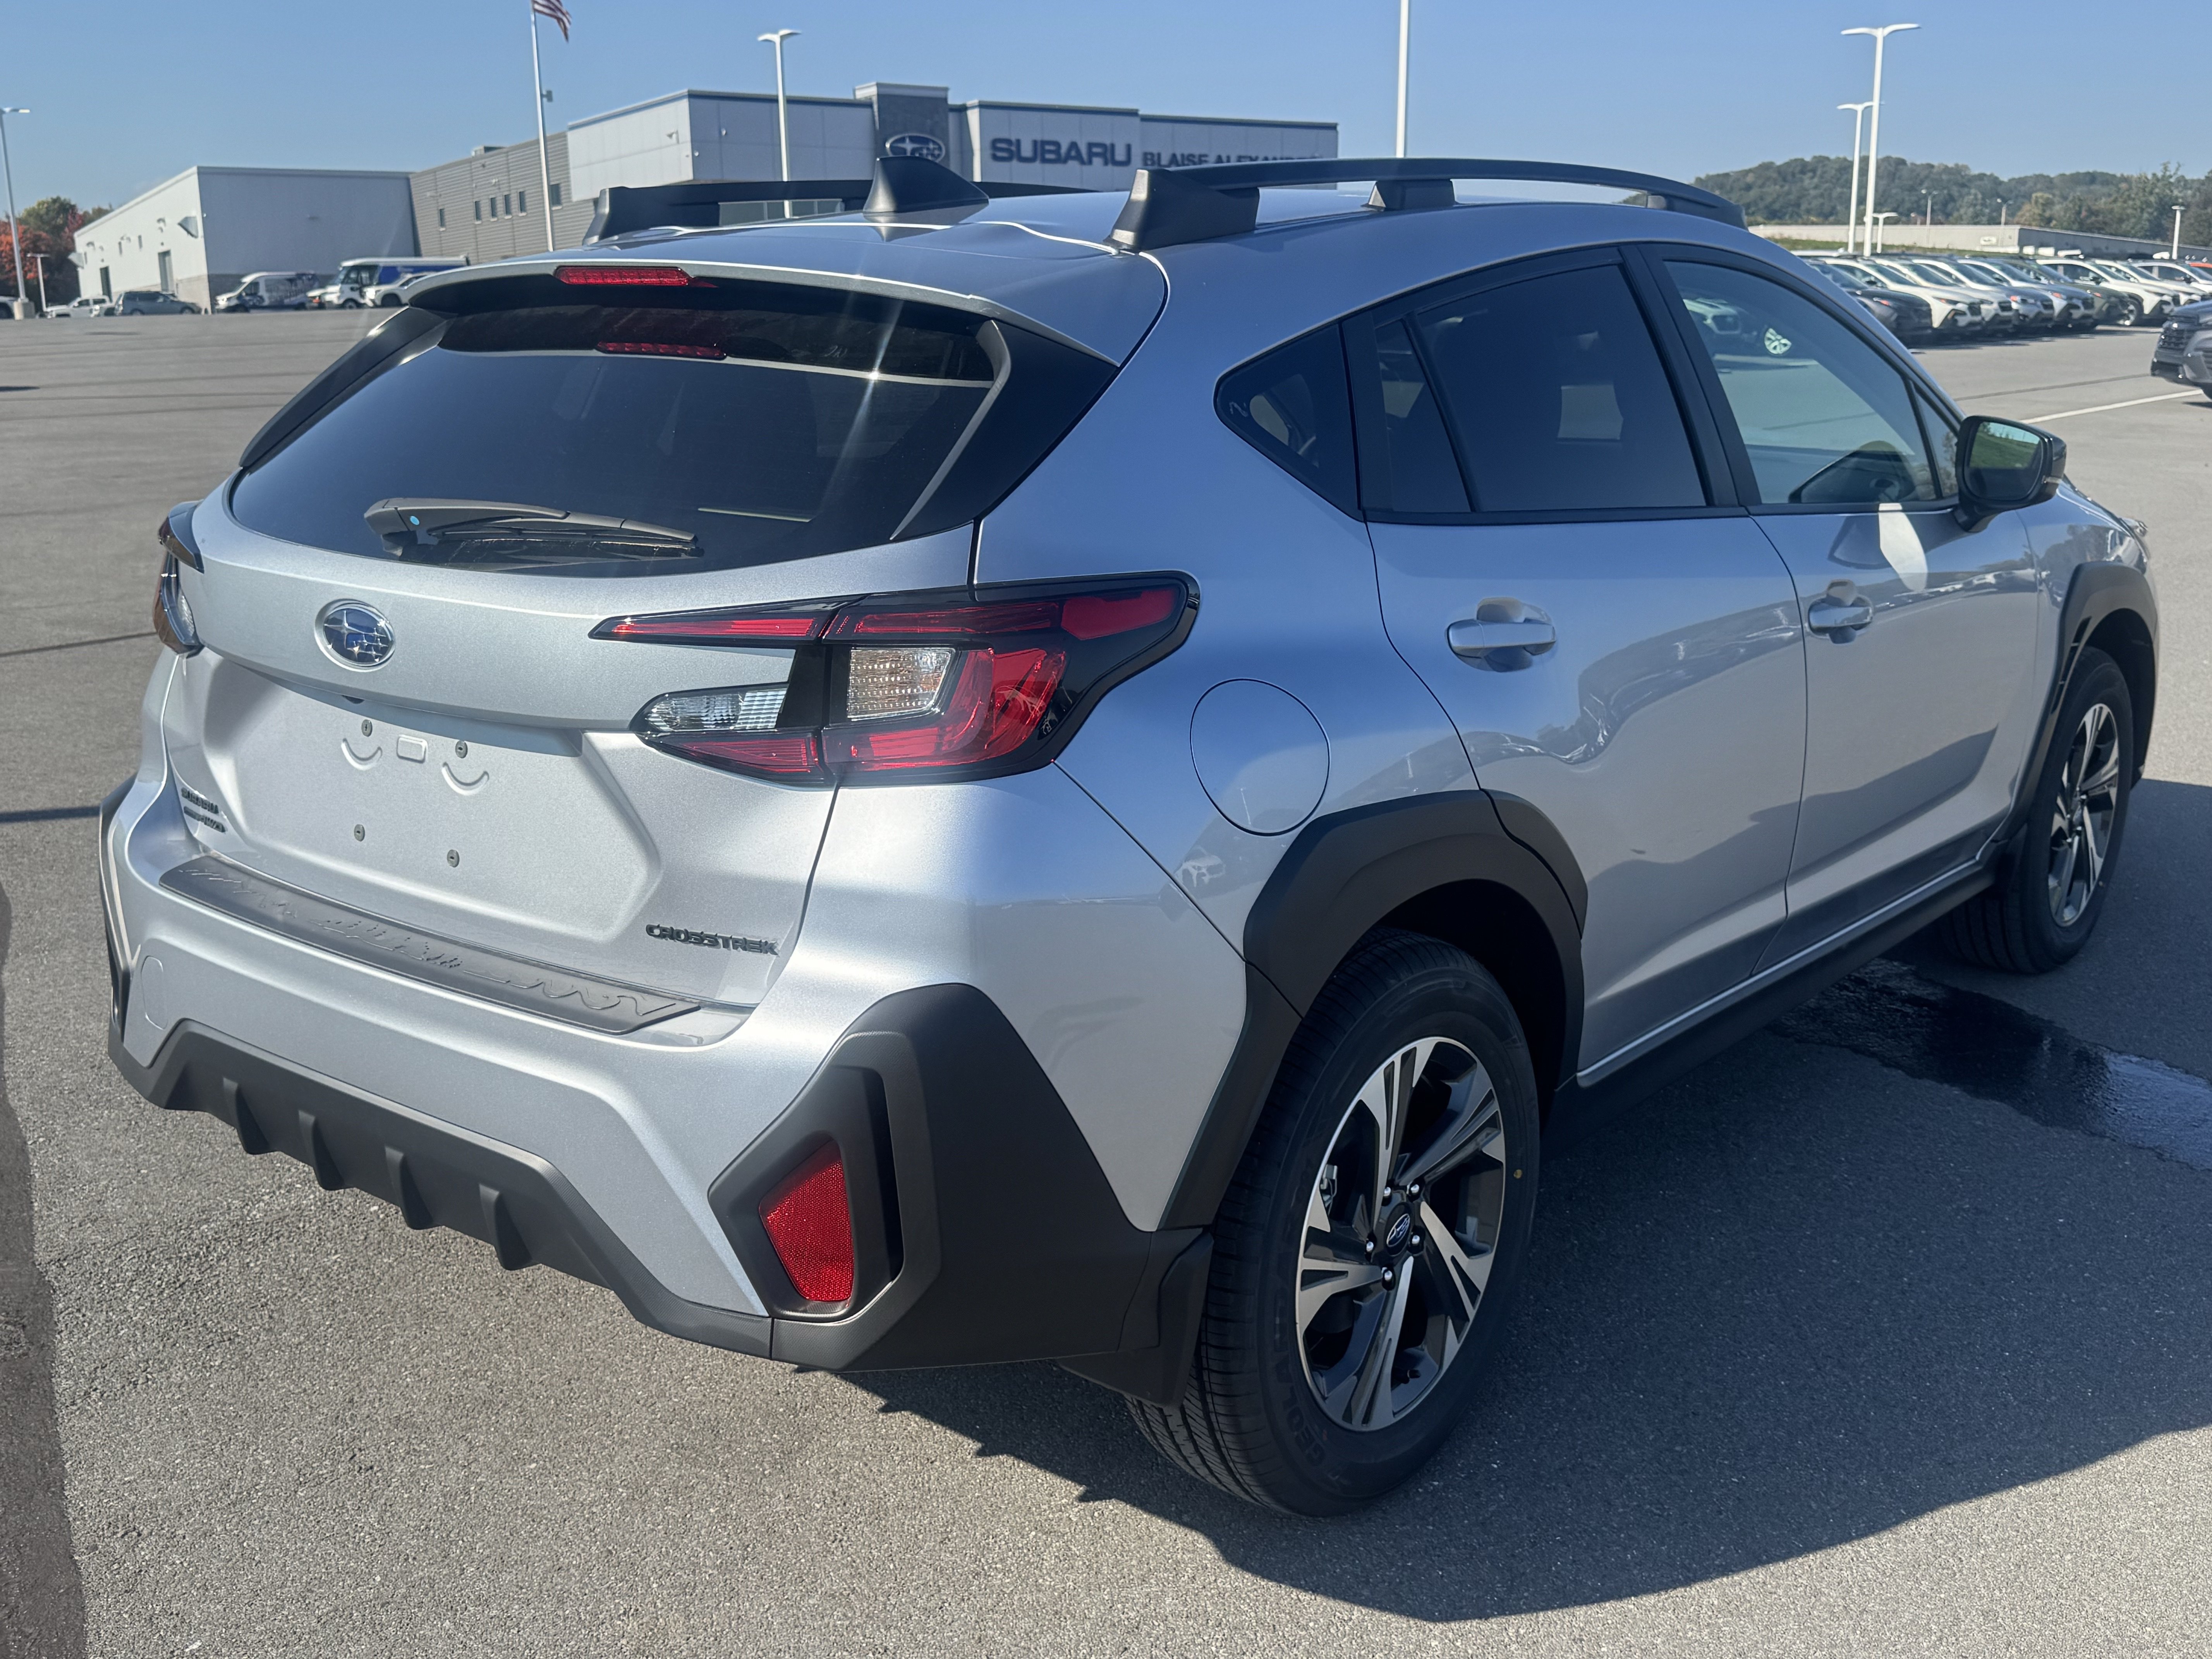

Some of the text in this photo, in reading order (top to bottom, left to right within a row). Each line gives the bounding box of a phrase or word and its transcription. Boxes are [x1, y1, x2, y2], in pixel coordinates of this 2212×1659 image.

[991, 137, 1132, 167] SUBARU
[1142, 151, 1209, 167] BLAISE
[181, 787, 219, 814] SUBARU
[646, 924, 779, 955] CROSSTREK
